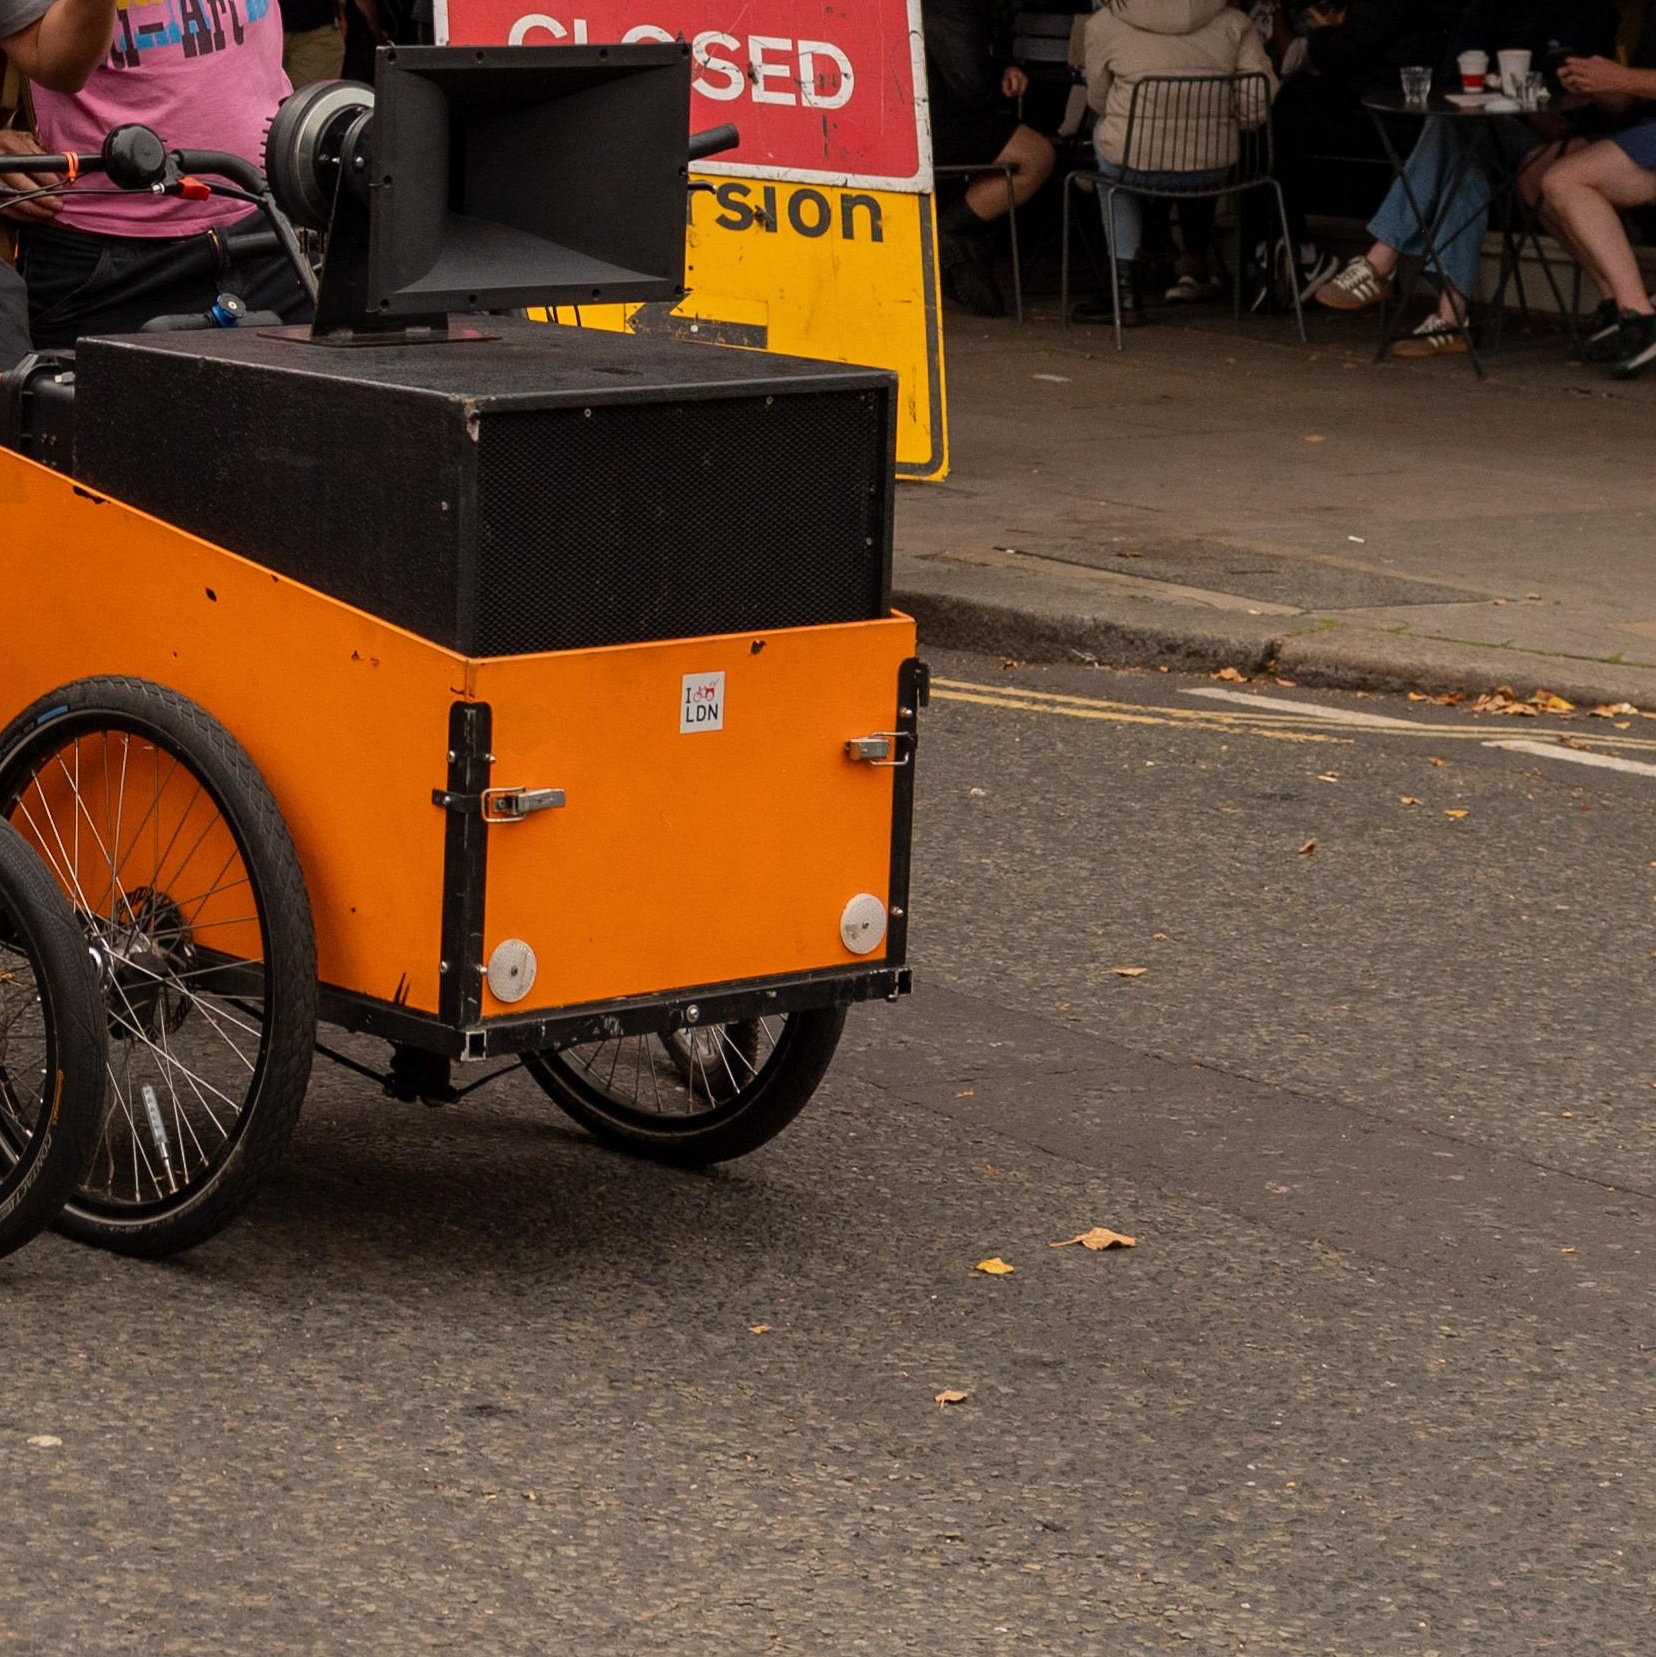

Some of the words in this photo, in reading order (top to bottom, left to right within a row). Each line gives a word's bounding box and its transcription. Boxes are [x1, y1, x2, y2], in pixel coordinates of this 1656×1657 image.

[508, 13, 855, 111] SED
[685, 687, 692, 704] I
[686, 703, 719, 723] LDN
